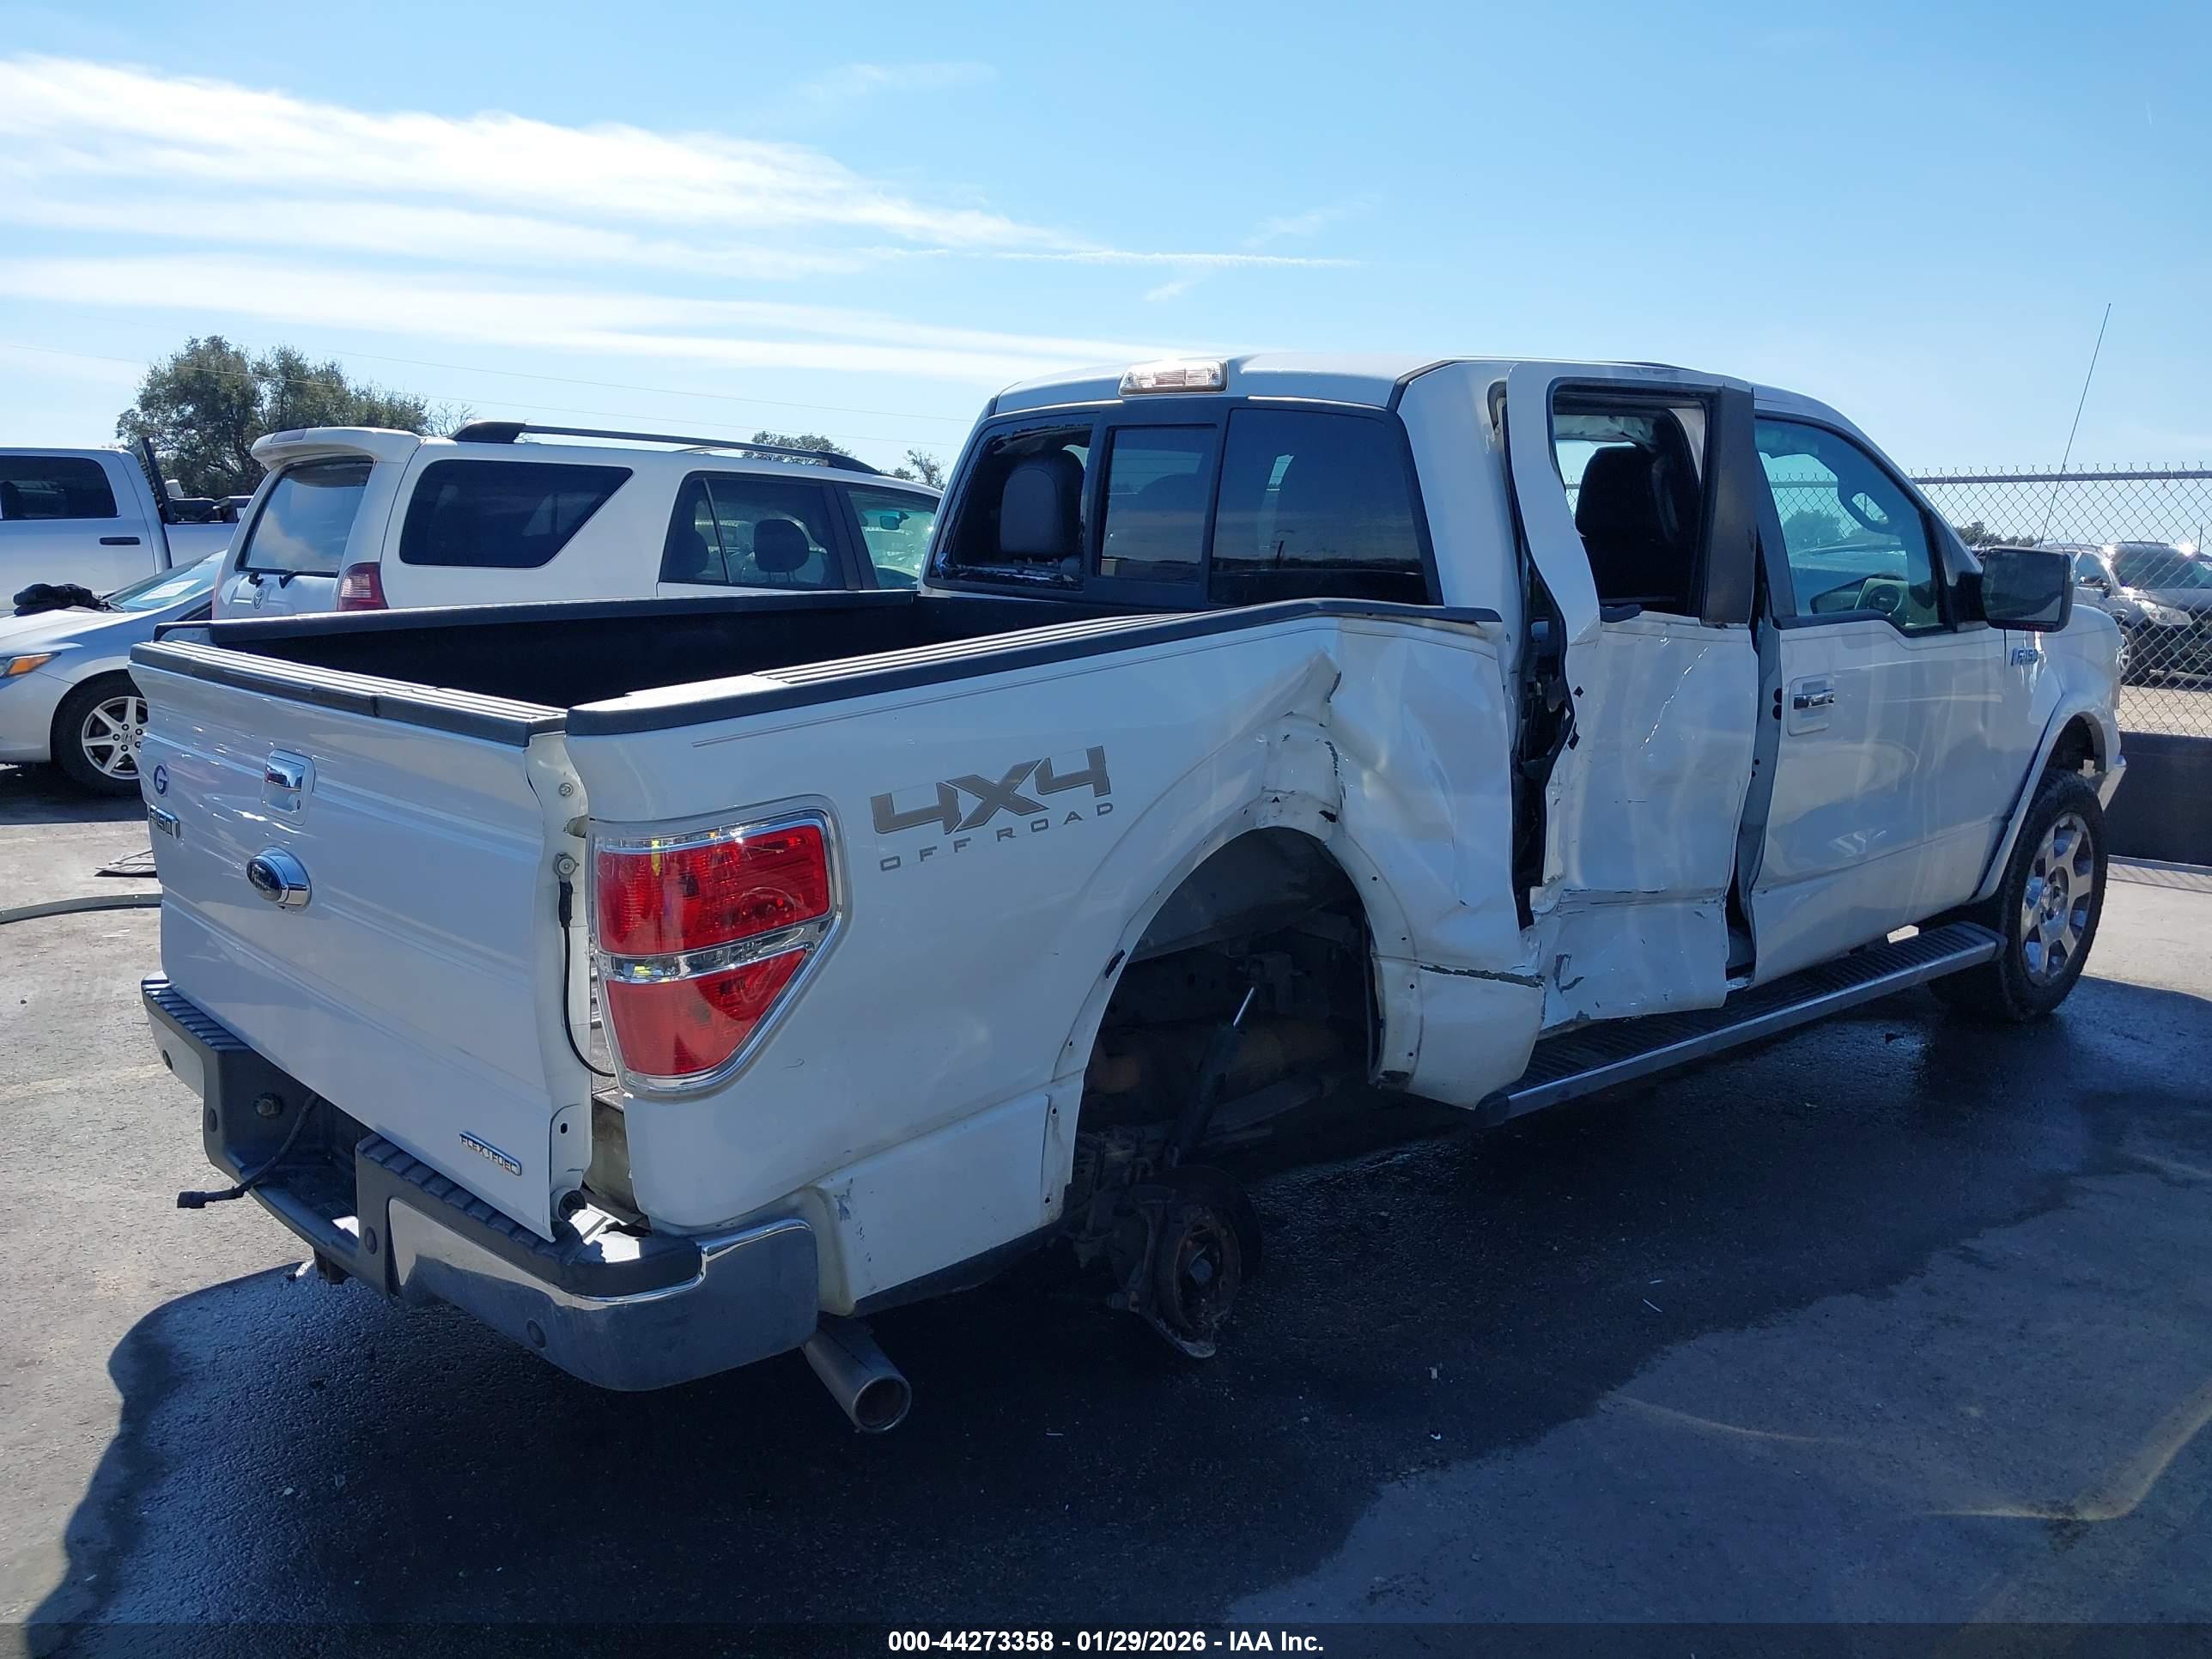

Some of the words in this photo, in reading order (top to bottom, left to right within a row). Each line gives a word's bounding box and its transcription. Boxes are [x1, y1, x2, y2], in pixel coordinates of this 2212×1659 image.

[154, 764, 167, 795] G
[870, 745, 1111, 836] 4X4
[879, 837, 971, 872] OFF
[996, 802, 1114, 842] ROAD
